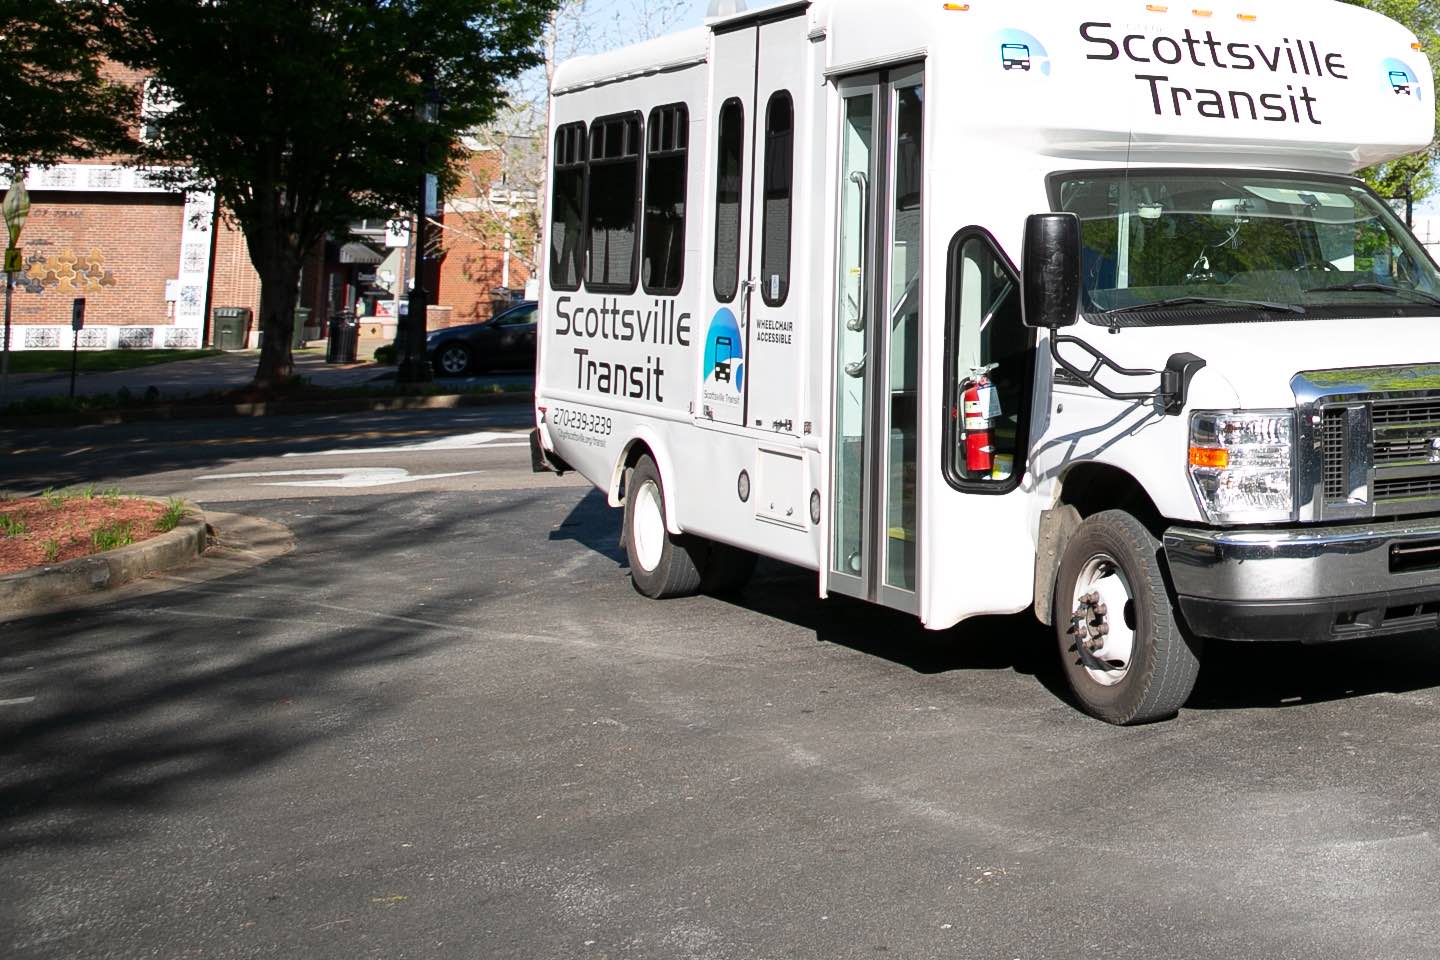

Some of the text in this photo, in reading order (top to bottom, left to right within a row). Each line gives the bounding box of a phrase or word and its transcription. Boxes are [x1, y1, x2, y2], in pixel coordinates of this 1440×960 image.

[1079, 21, 1348, 79] Scottsville
[1134, 74, 1322, 125] Transit
[555, 296, 691, 347] Scottsville
[756, 318, 793, 331] WHEELCHAIR
[756, 333, 792, 345] ACCESSIBLE
[574, 347, 664, 403] Transit
[553, 407, 612, 436] 270-239-3239
